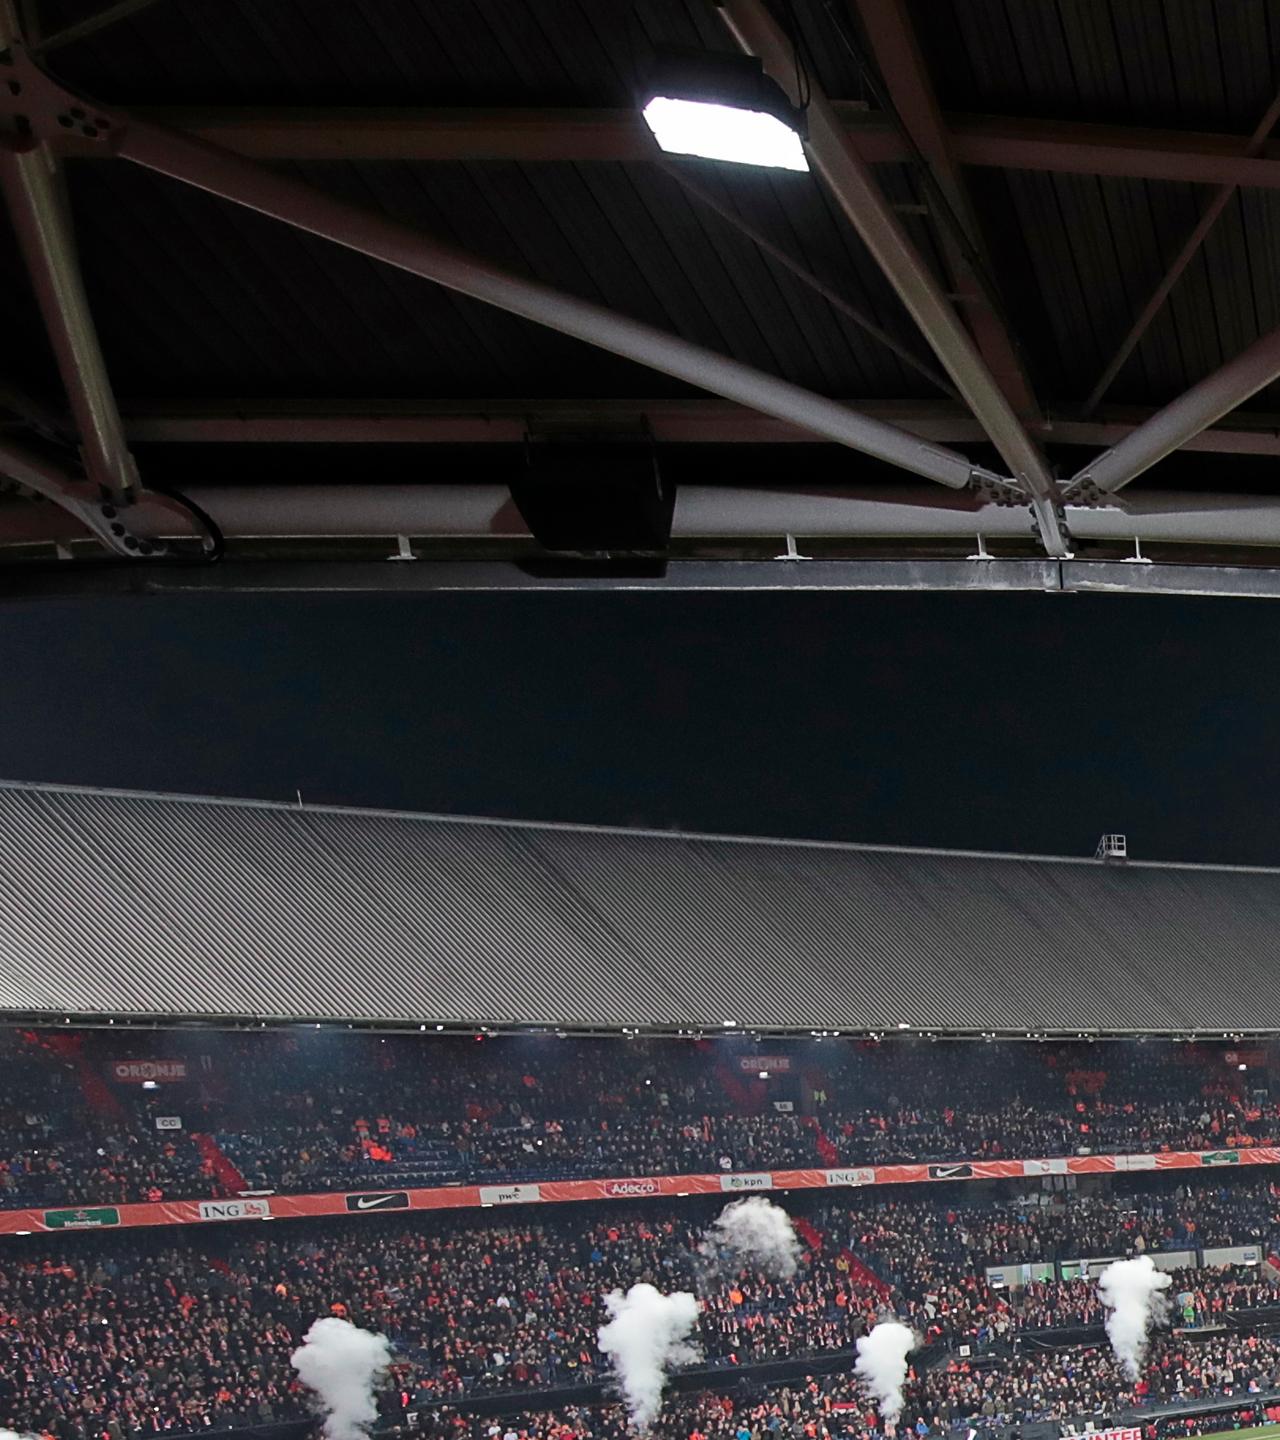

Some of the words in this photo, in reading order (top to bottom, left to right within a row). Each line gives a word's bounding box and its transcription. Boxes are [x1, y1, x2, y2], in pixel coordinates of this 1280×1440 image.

[743, 1178, 763, 1188] kpn
[829, 1172, 853, 1184] ING
[612, 1182, 655, 1194] Adecco
[203, 1205, 240, 1219] ING
